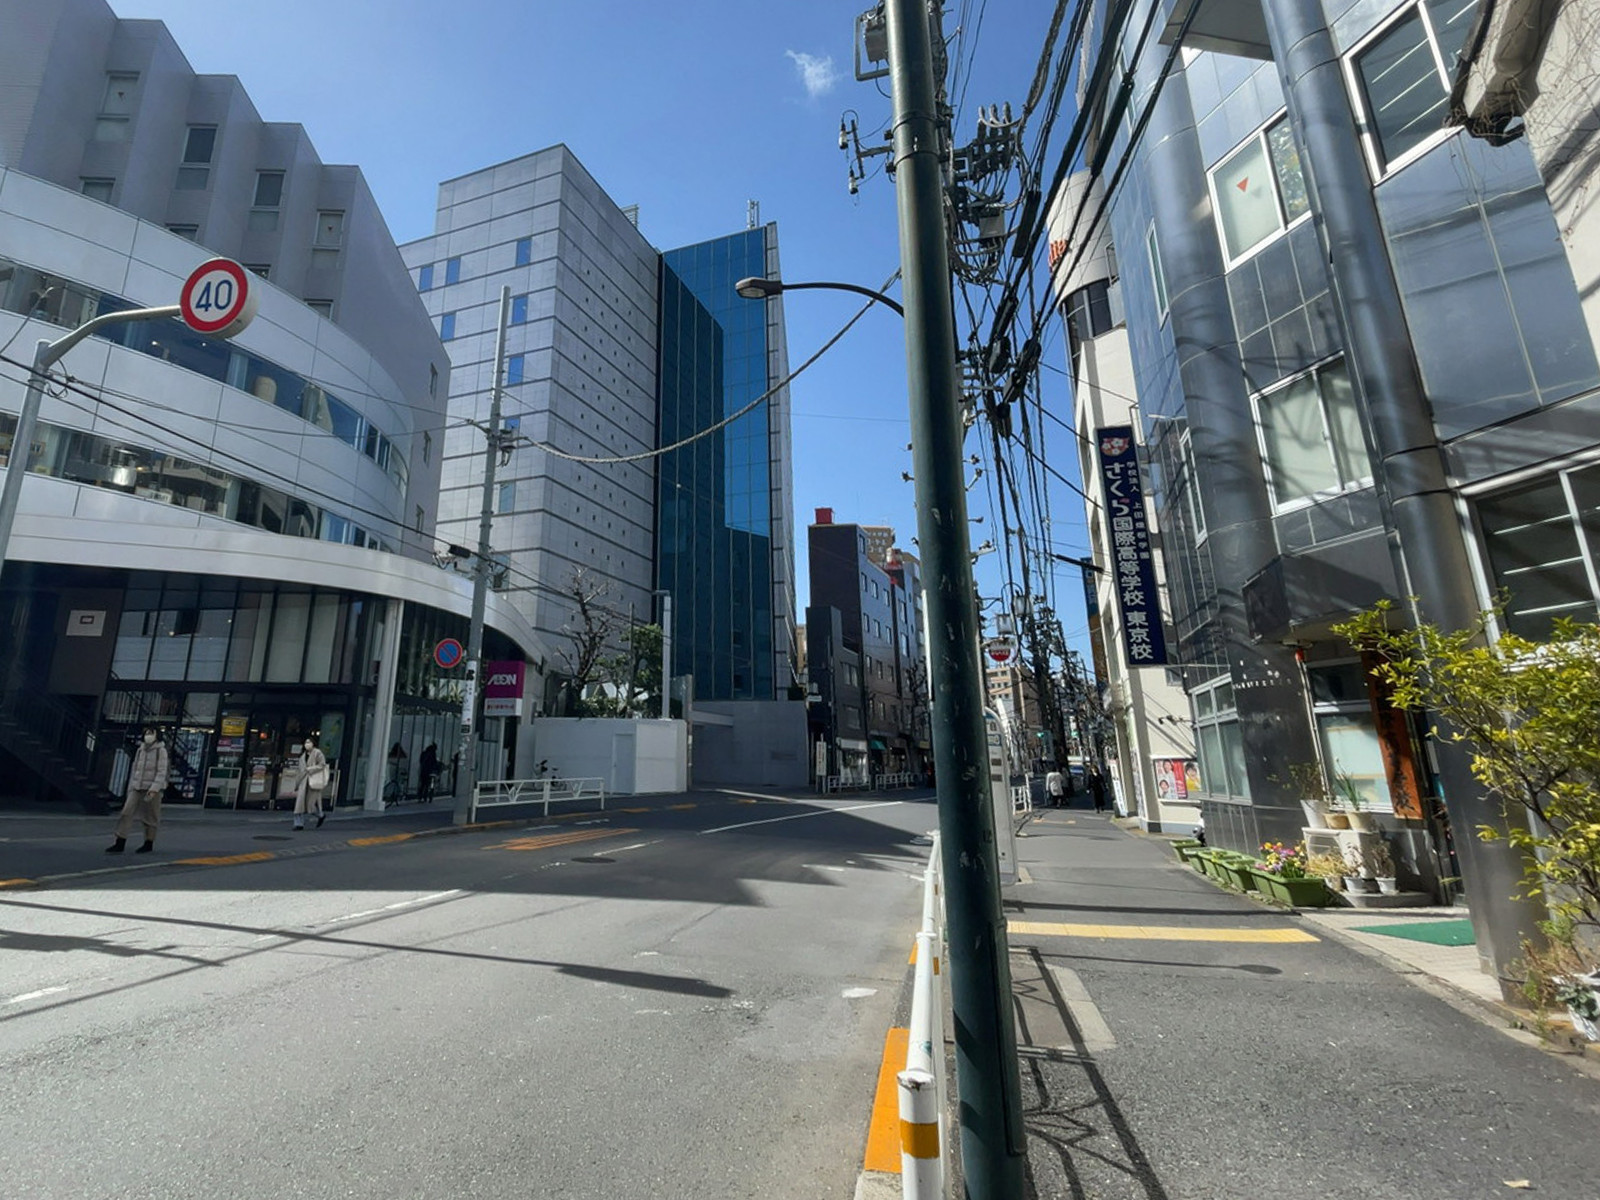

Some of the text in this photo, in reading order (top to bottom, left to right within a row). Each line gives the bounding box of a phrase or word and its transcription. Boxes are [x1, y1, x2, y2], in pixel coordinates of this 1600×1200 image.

[195, 279, 233, 312] 40
[1105, 462, 1154, 660] さくら国際高等学校 東京校
[487, 673, 517, 686] AEON
